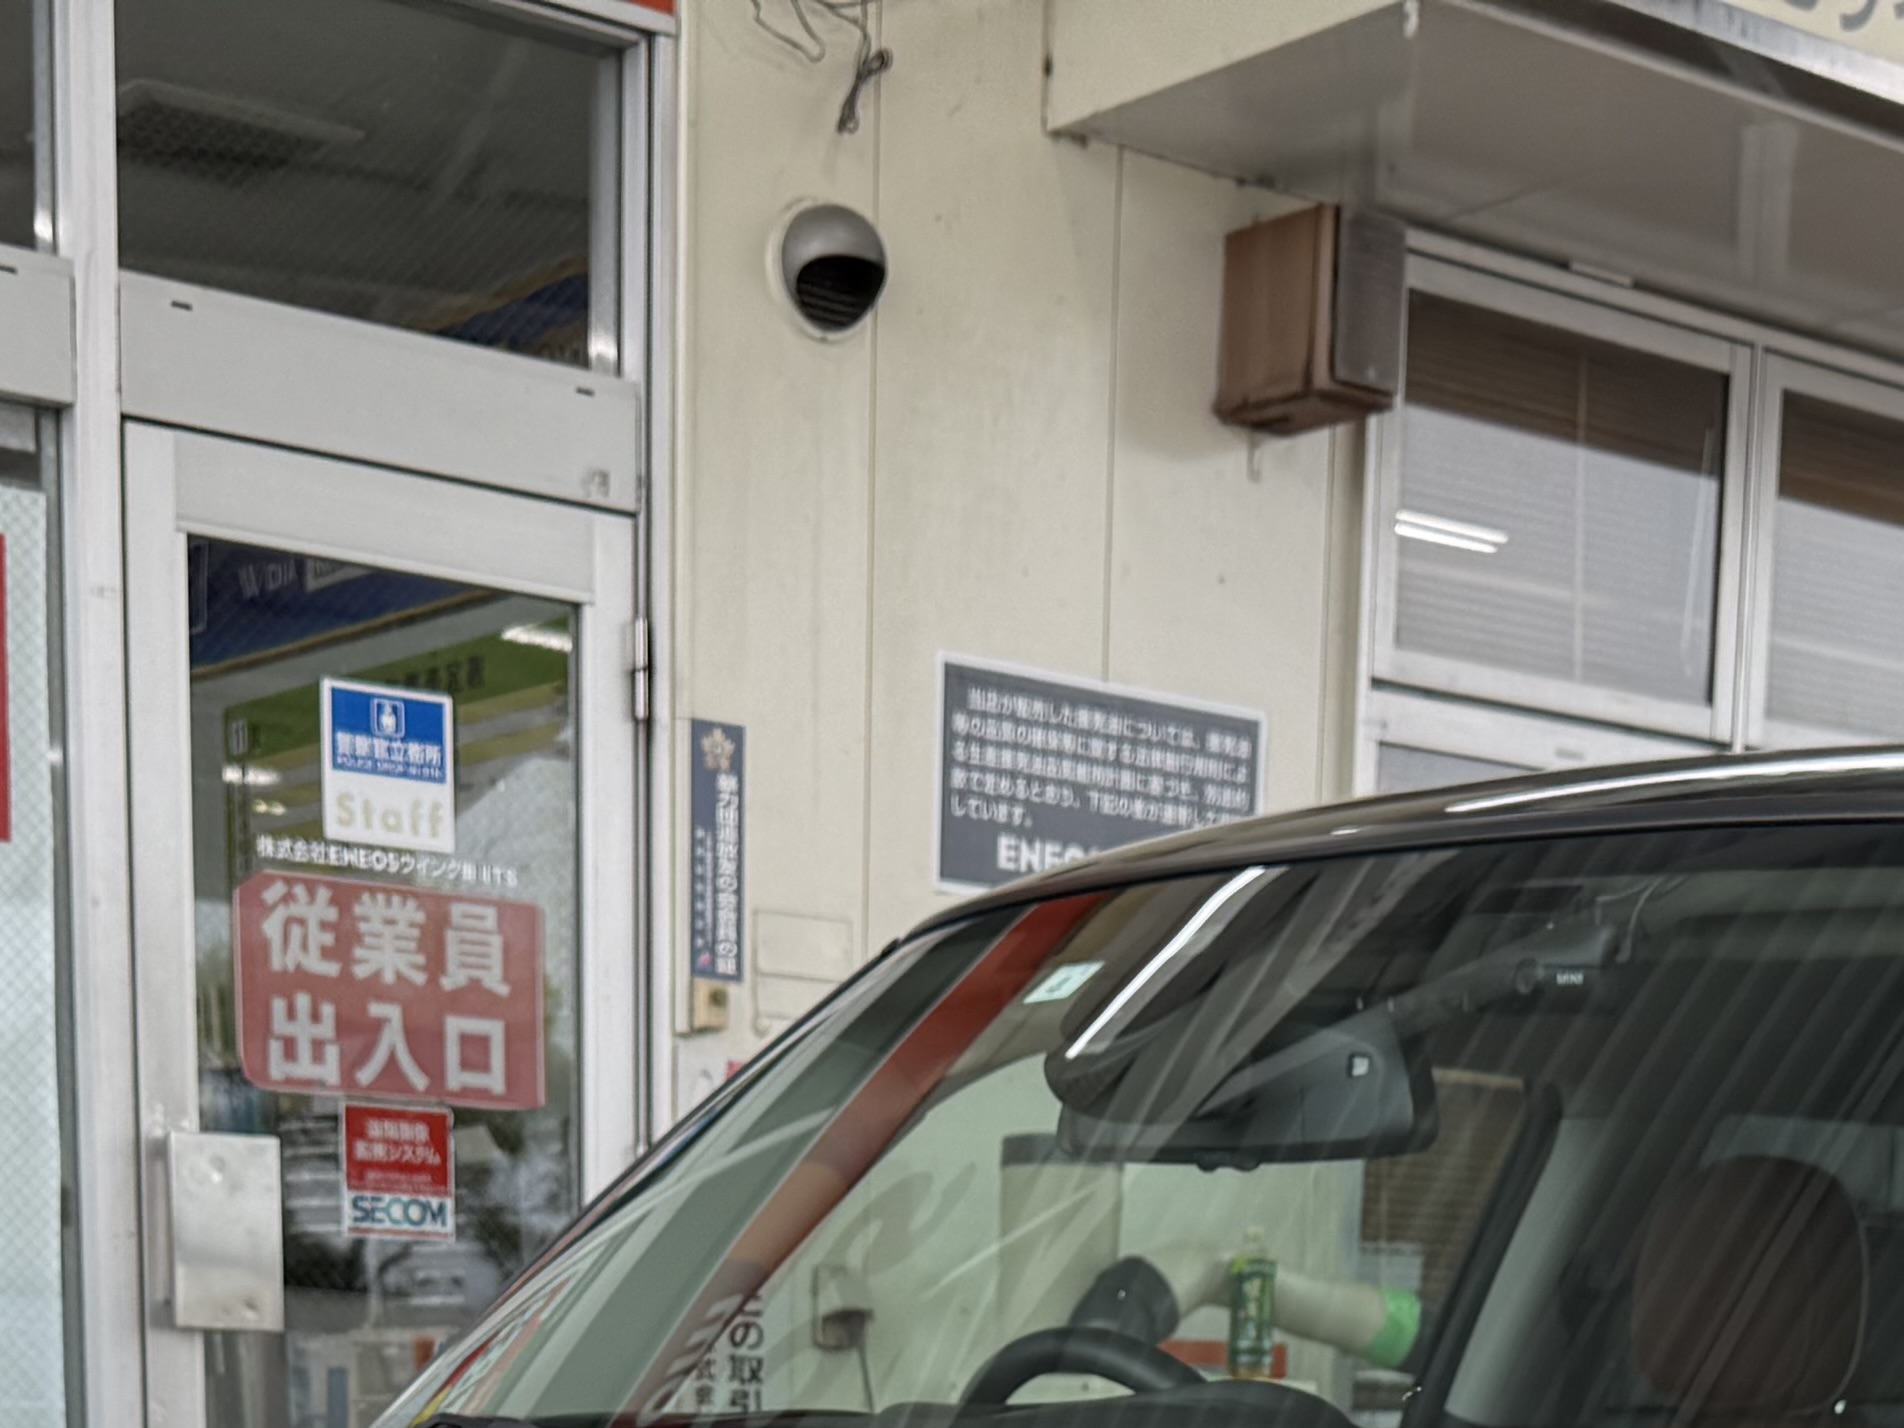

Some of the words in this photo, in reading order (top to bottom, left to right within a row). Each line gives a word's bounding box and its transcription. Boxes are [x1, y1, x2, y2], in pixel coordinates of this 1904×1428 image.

[334, 791, 445, 840] Staff
[997, 832, 1099, 873] ENE
[259, 878, 512, 998] 従業員
[266, 993, 508, 1096] 出入口
[351, 1193, 448, 1229] SECOM
